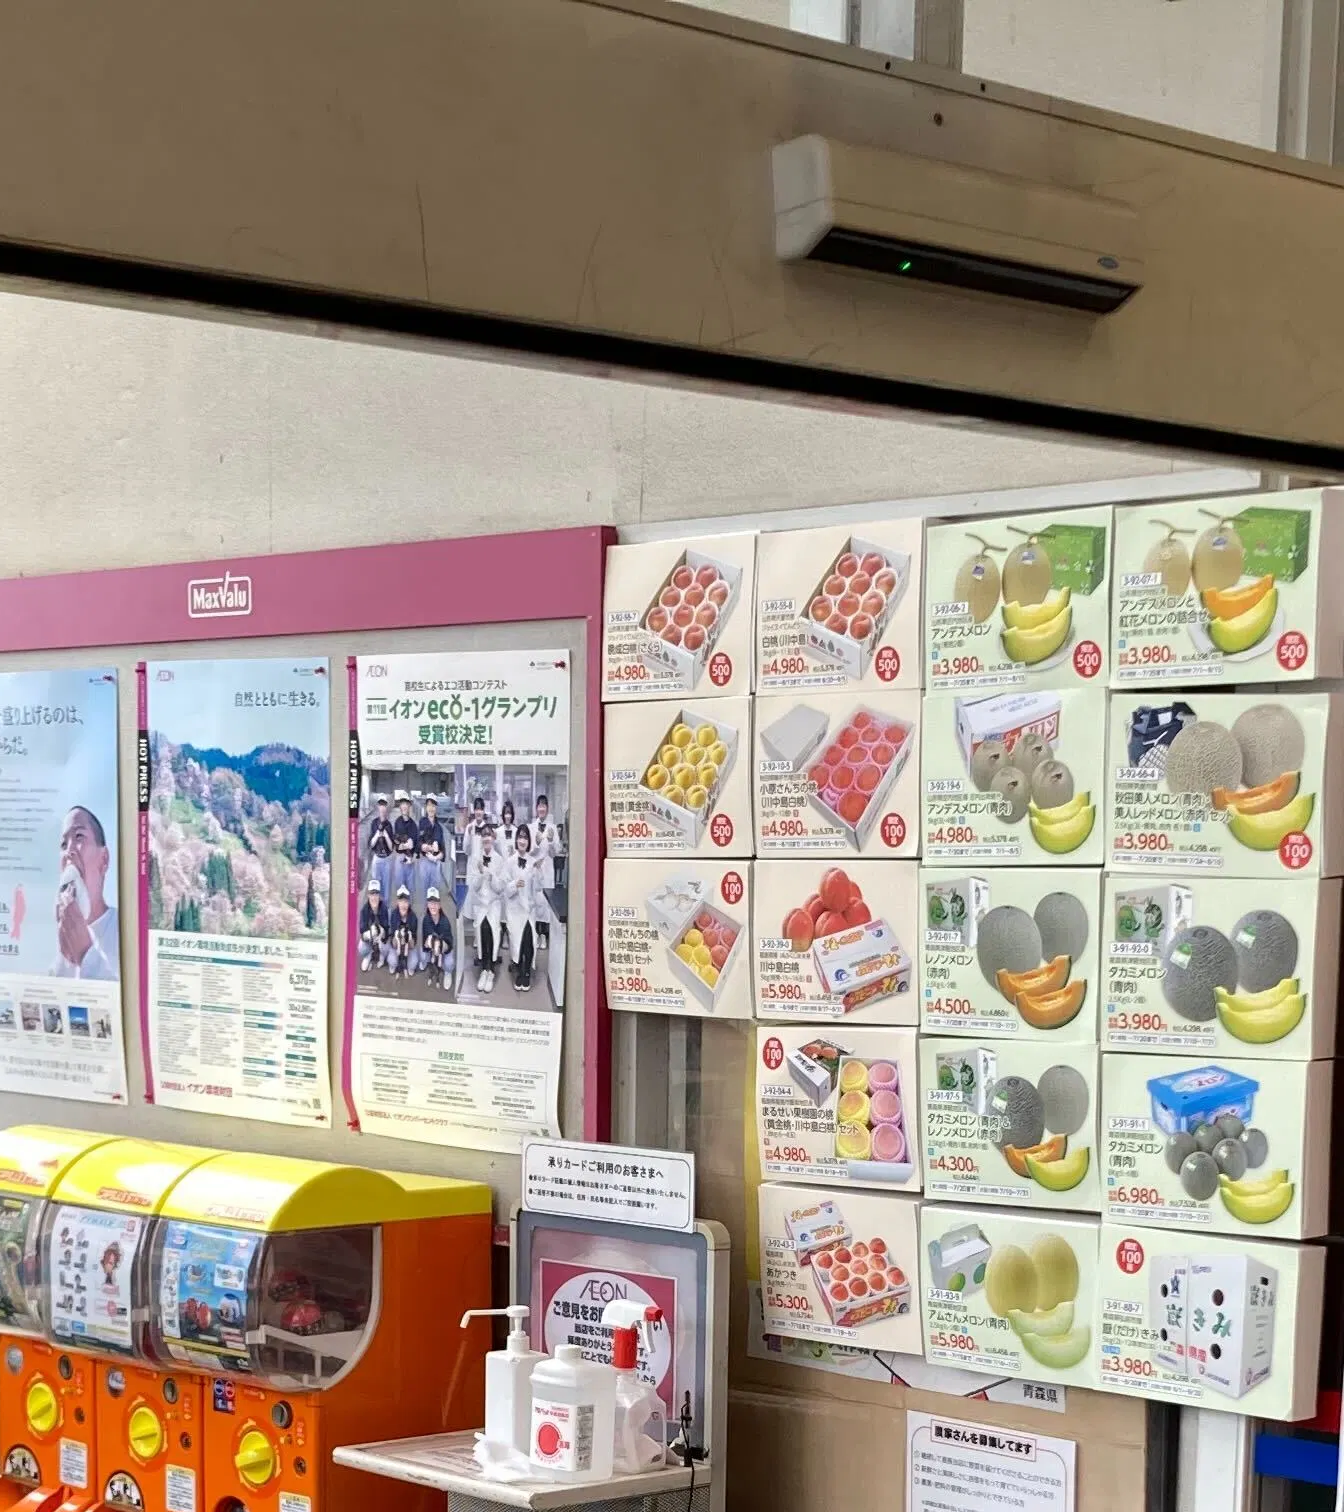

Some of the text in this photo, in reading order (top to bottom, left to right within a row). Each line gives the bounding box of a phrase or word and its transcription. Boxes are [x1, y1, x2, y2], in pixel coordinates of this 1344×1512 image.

[193, 571, 246, 610] MaxValu
[1119, 596, 1194, 612] アンデスメロンと
[931, 624, 992, 640] アンデスメロン
[1280, 645, 1304, 658] 500
[878, 658, 898, 671] 500
[1077, 655, 1098, 666] 500
[235, 691, 320, 708] 自然とともに生きる。
[712, 824, 731, 836] 500
[884, 824, 903, 837] 100
[1284, 845, 1309, 858] 100
[723, 883, 741, 894] 100
[926, 955, 973, 965] レノンメロン
[1108, 967, 1167, 980] タカミメロン
[1108, 1142, 1164, 1155] タカミメロン
[547, 1156, 664, 1179] 承りカードご利用のお客さまへ
[1120, 1251, 1141, 1265] 100
[766, 1267, 797, 1281] あかつき
[1022, 1383, 1058, 1404] 青森県
[934, 1425, 1033, 1455] 農家さんを募集してます
